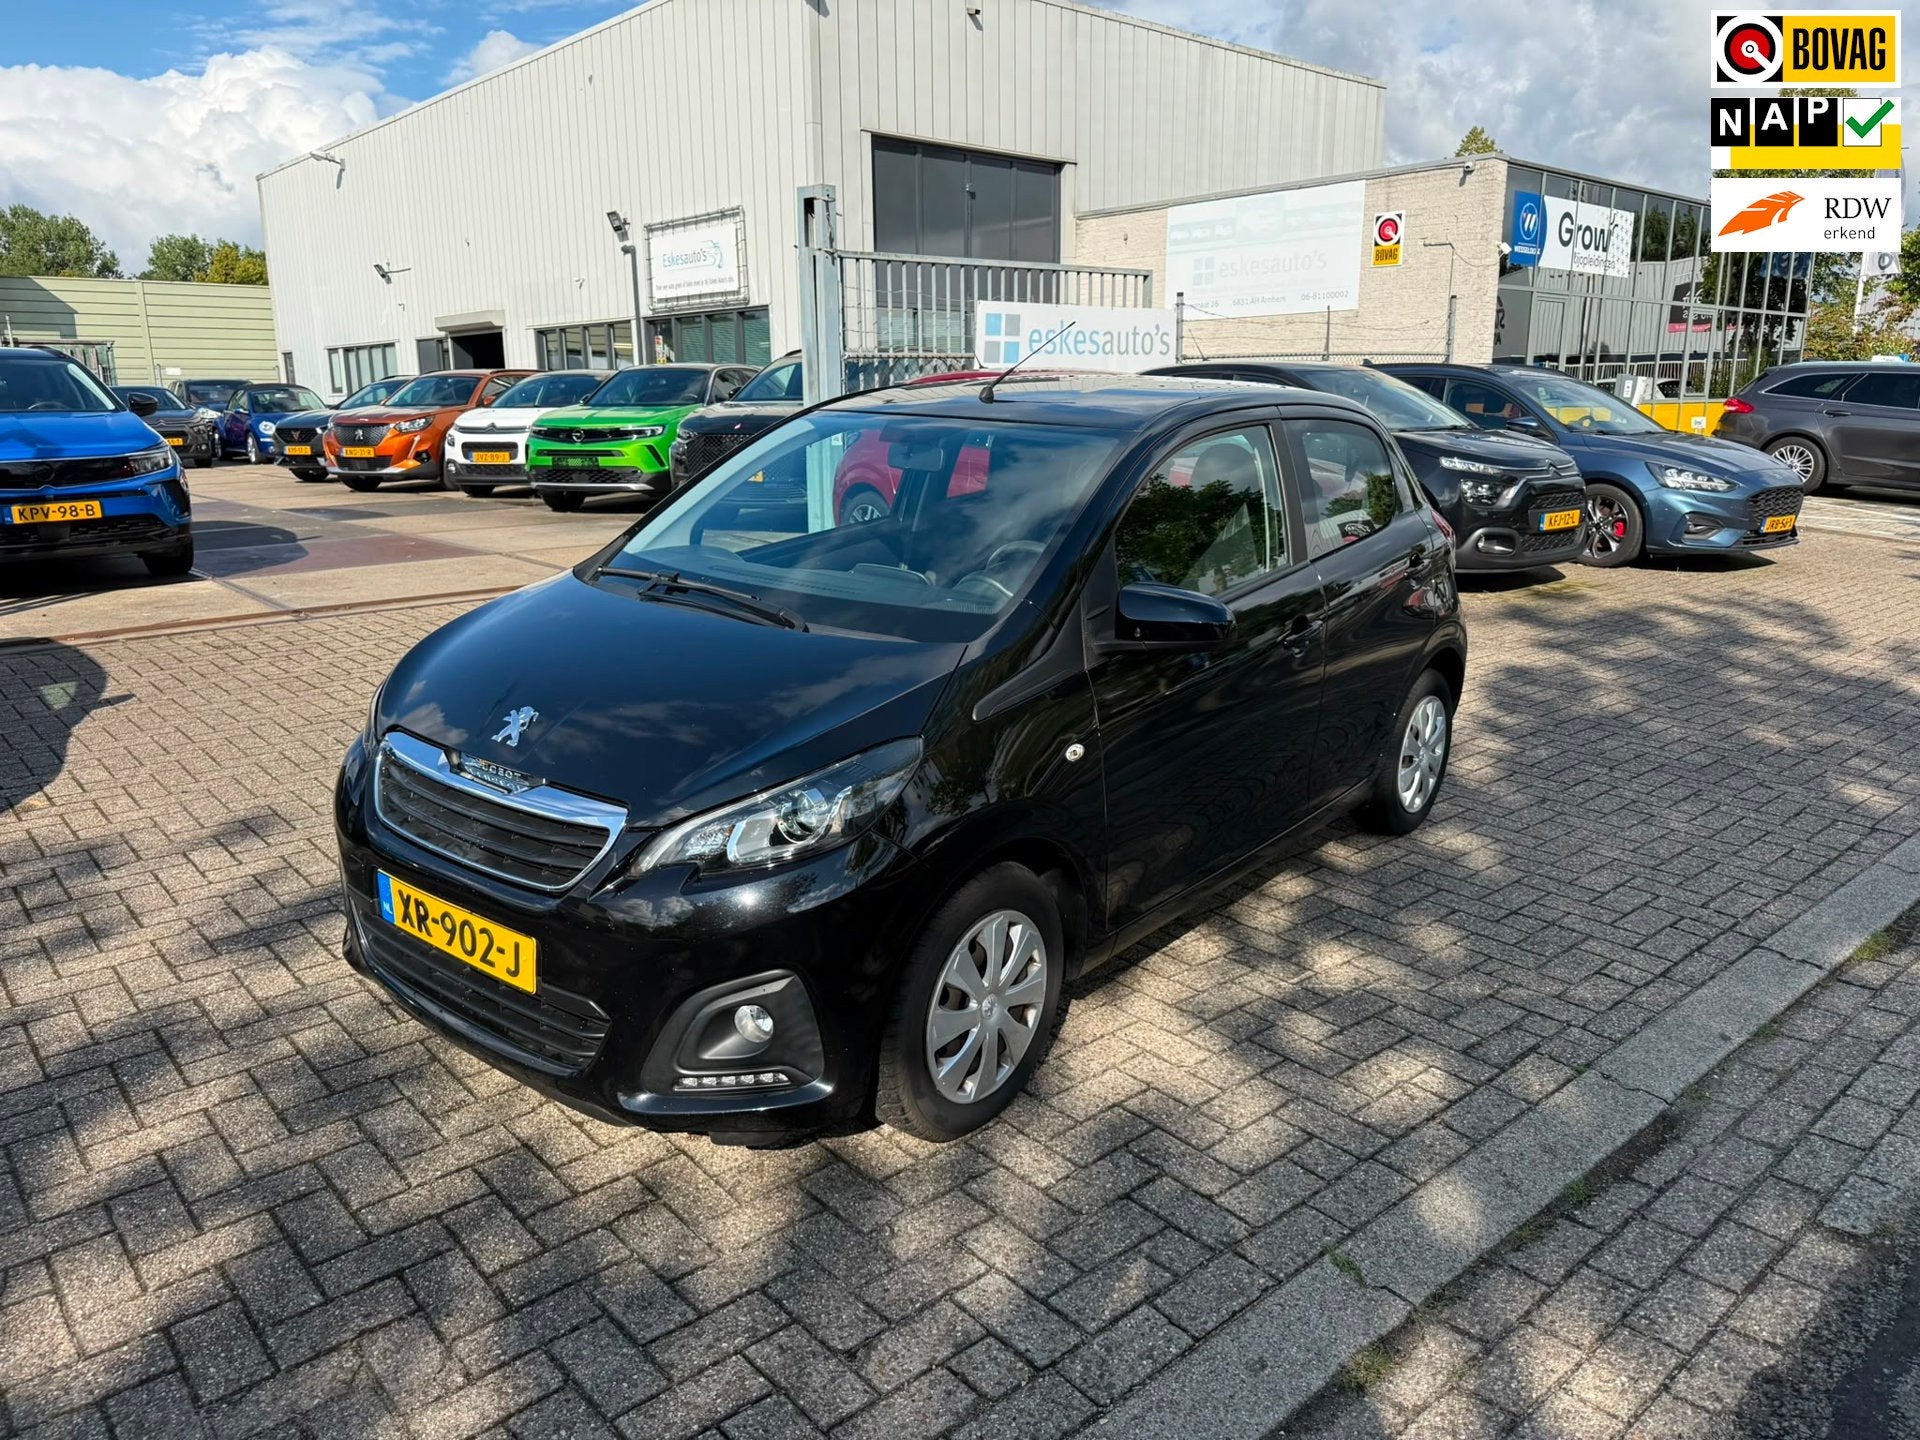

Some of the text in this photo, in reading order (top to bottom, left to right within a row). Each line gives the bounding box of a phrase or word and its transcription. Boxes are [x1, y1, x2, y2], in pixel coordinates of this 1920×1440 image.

[1218, 249, 1328, 279] eskesauto's
[1375, 247, 1398, 261] BOVAG
[1028, 320, 1170, 356] eskesauto's
[18, 504, 95, 521] KPV-98-B
[383, 889, 520, 978] NL XR-902-J
